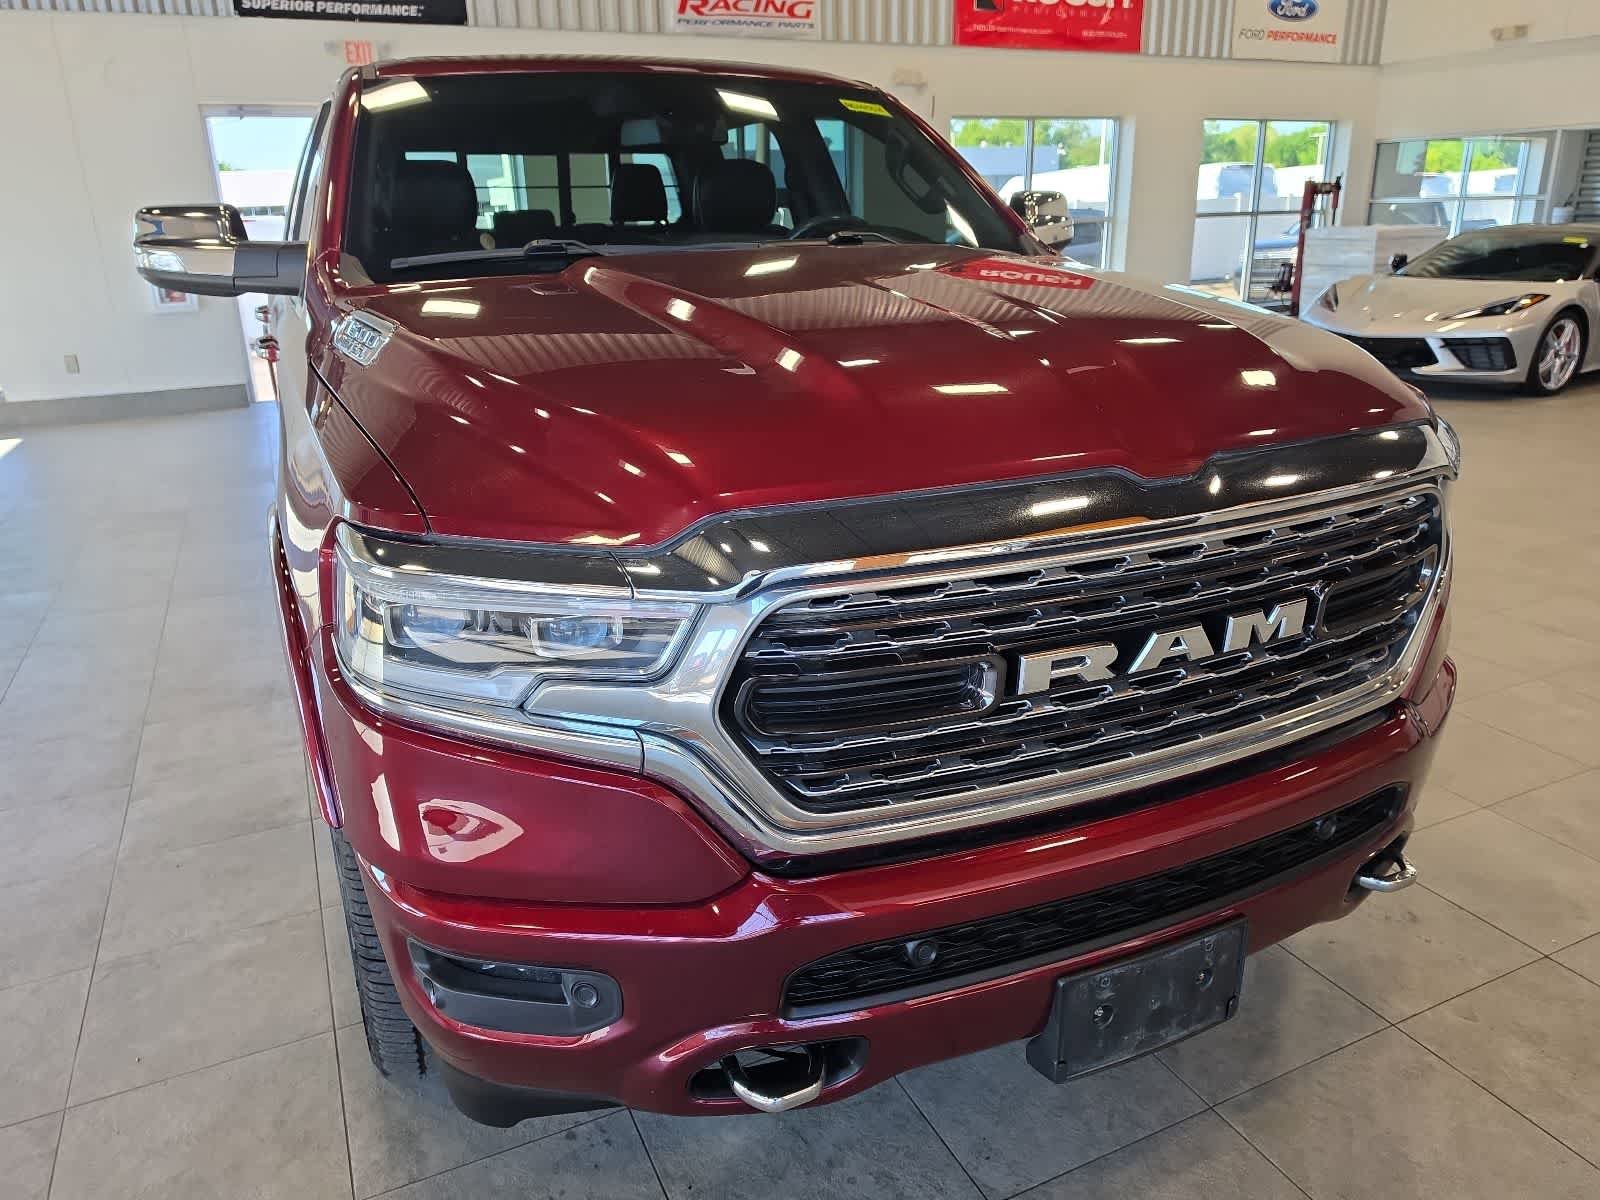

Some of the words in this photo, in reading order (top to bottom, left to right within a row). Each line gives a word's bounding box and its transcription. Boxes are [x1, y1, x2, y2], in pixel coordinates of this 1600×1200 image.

[242, 0, 314, 12] SUPERIOR
[678, 0, 815, 19] RACING
[1276, 0, 1310, 16] Ford
[677, 18, 775, 28] PERFORMANCE
[778, 21, 814, 29] PARTS
[1239, 28, 1265, 40] FORD
[1267, 30, 1336, 45] PERFORMANCE
[344, 41, 372, 64] EXIT
[1017, 598, 1308, 696] RAM
